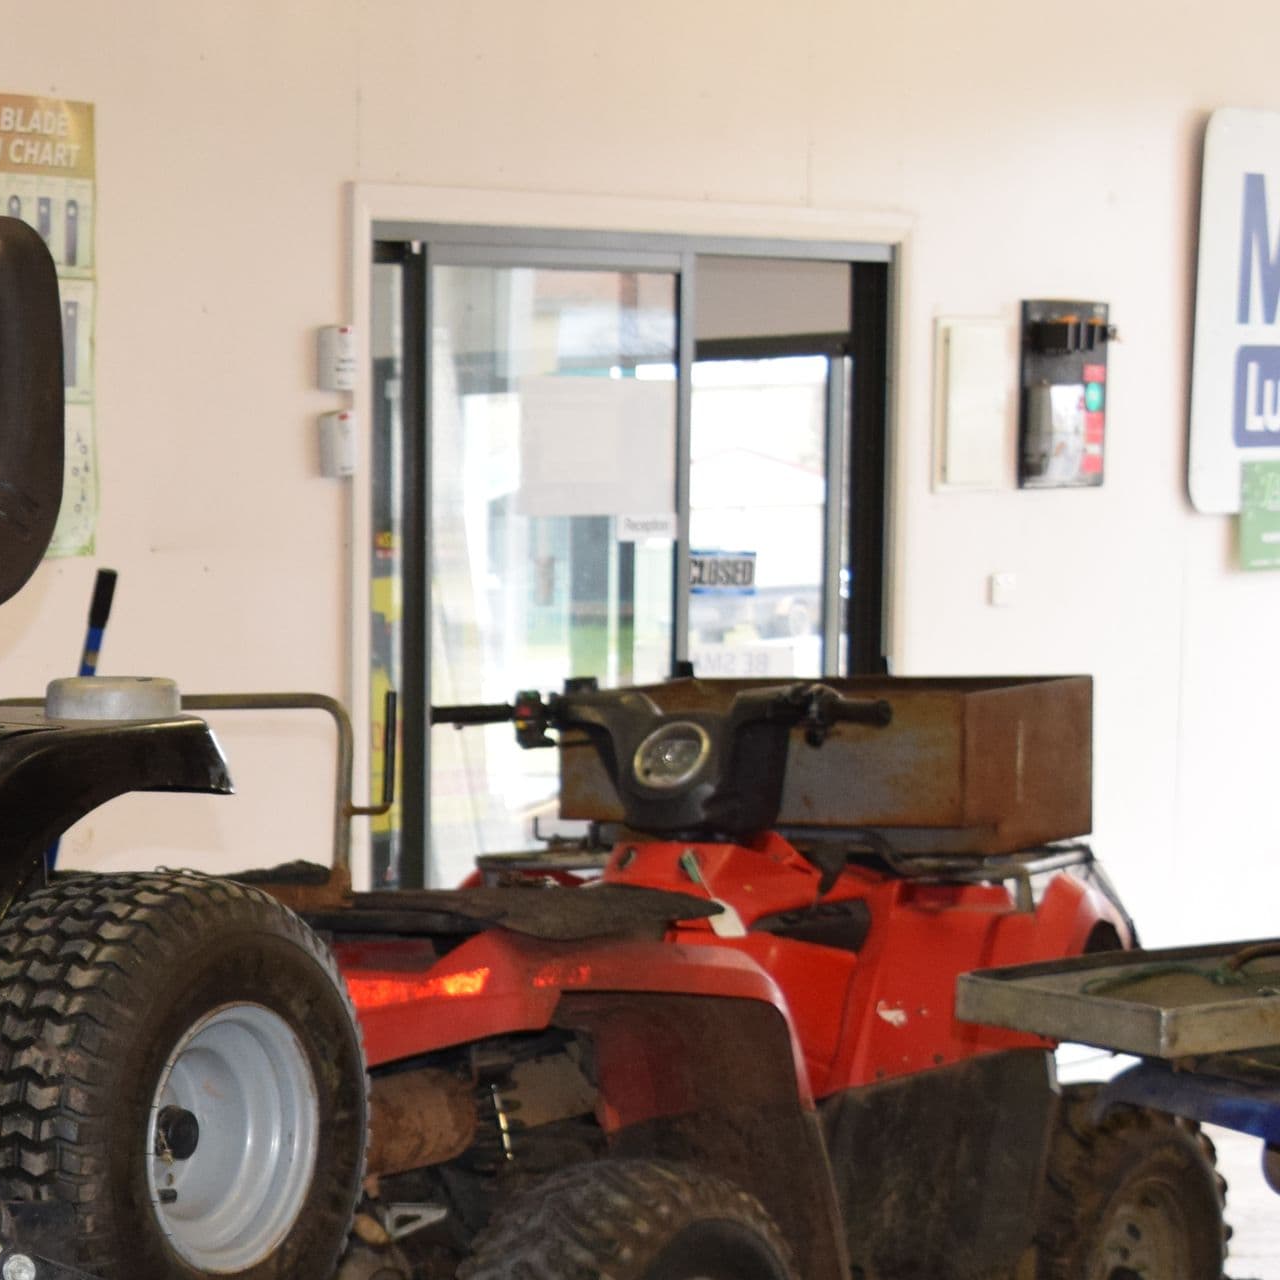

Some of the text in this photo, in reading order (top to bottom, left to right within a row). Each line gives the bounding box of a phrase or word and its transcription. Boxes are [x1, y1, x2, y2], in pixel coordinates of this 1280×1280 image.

[0, 107, 70, 137] BLADE
[9, 138, 81, 168] CHART
[688, 559, 754, 585] CLOSED
